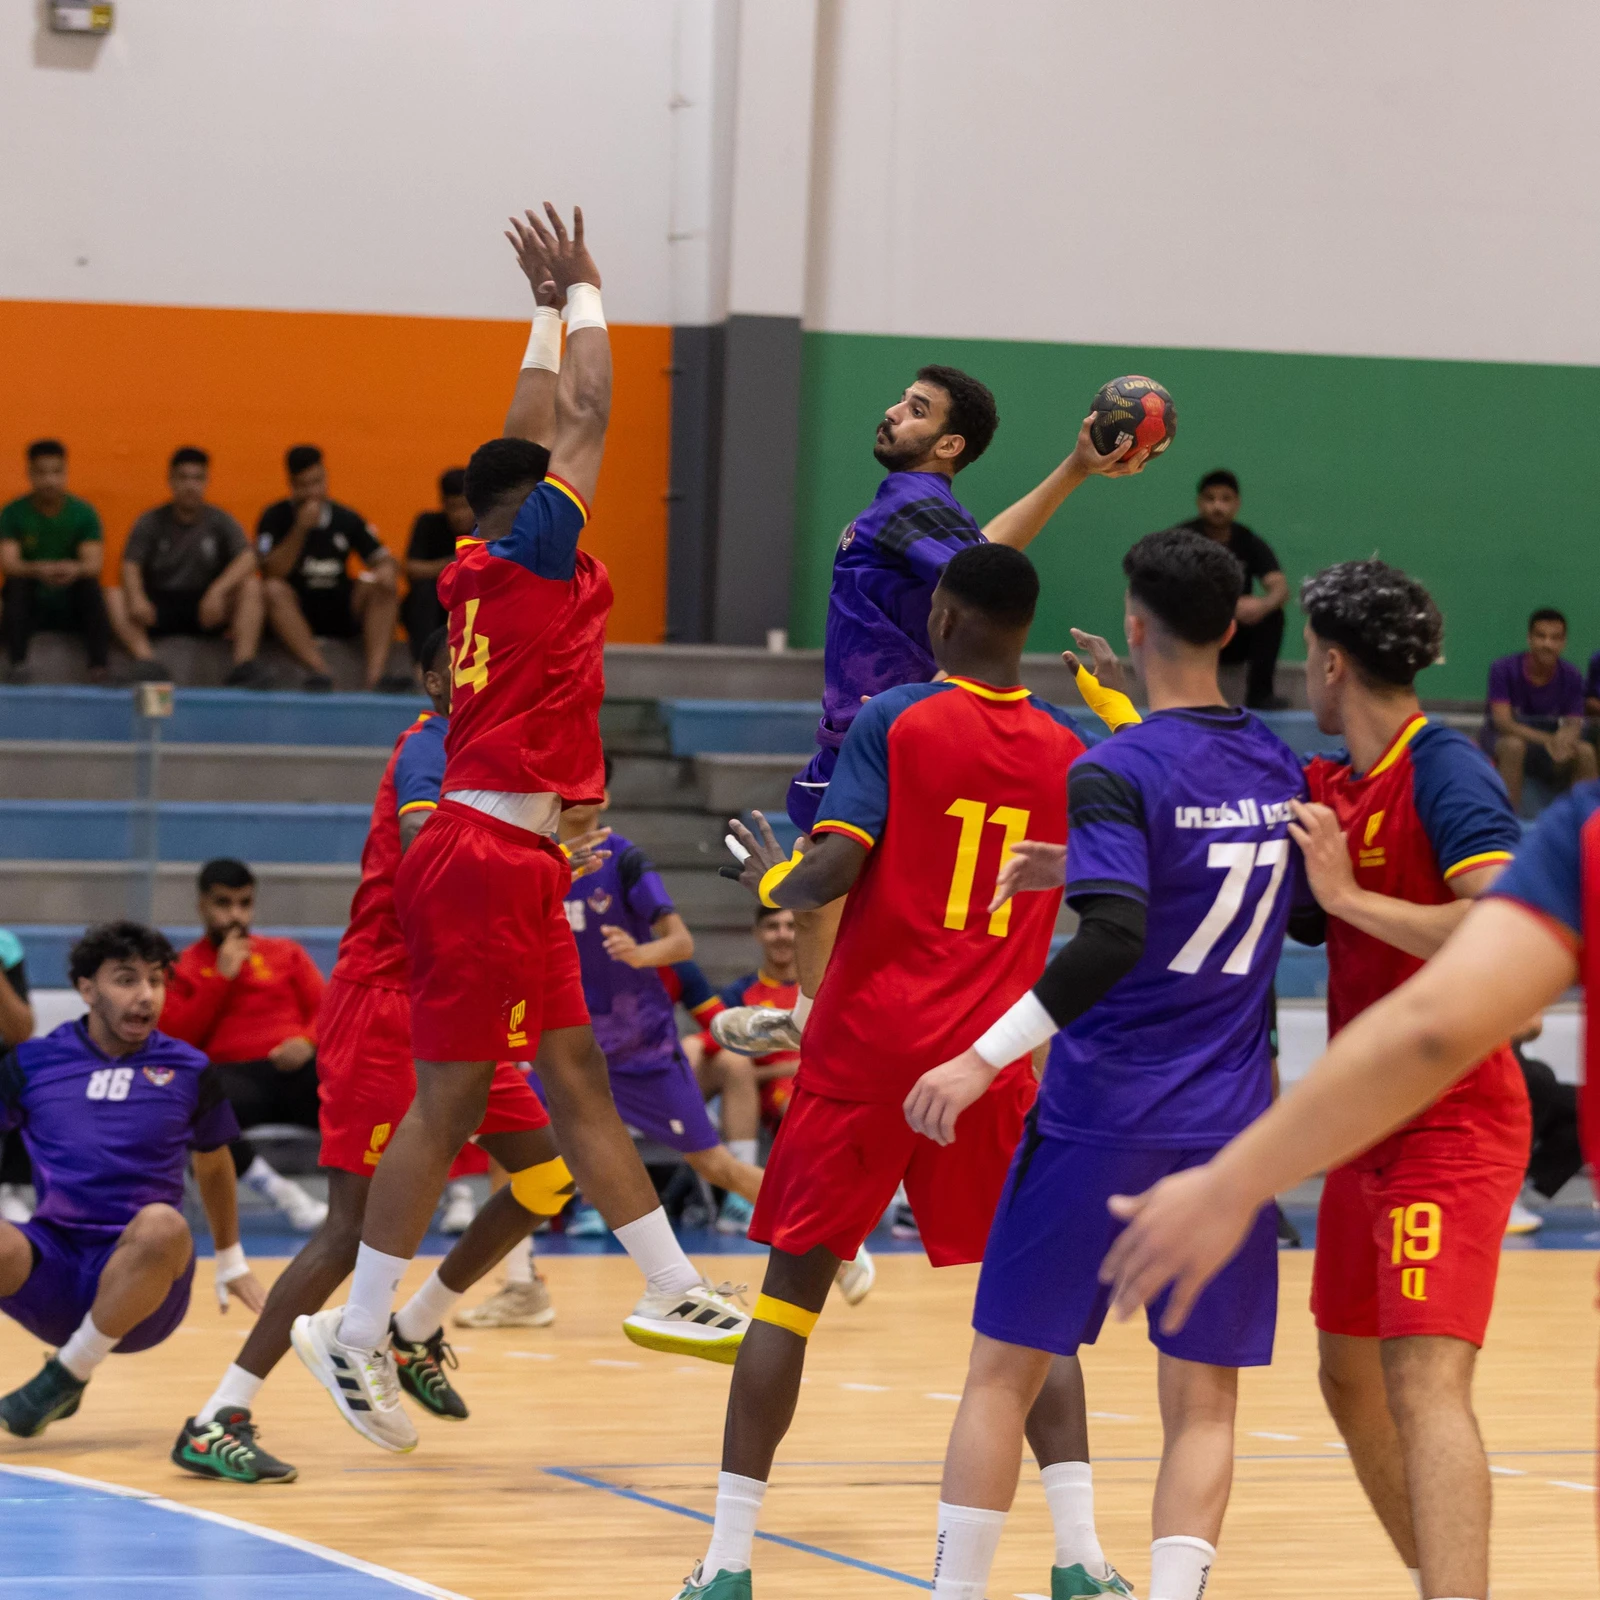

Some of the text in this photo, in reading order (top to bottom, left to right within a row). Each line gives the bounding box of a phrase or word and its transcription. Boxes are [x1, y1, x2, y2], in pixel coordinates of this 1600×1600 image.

[944, 798, 1030, 937] 11
[1167, 839, 1289, 975] 77
[86, 1067, 135, 1101] 86
[1388, 1202, 1442, 1265] 19
